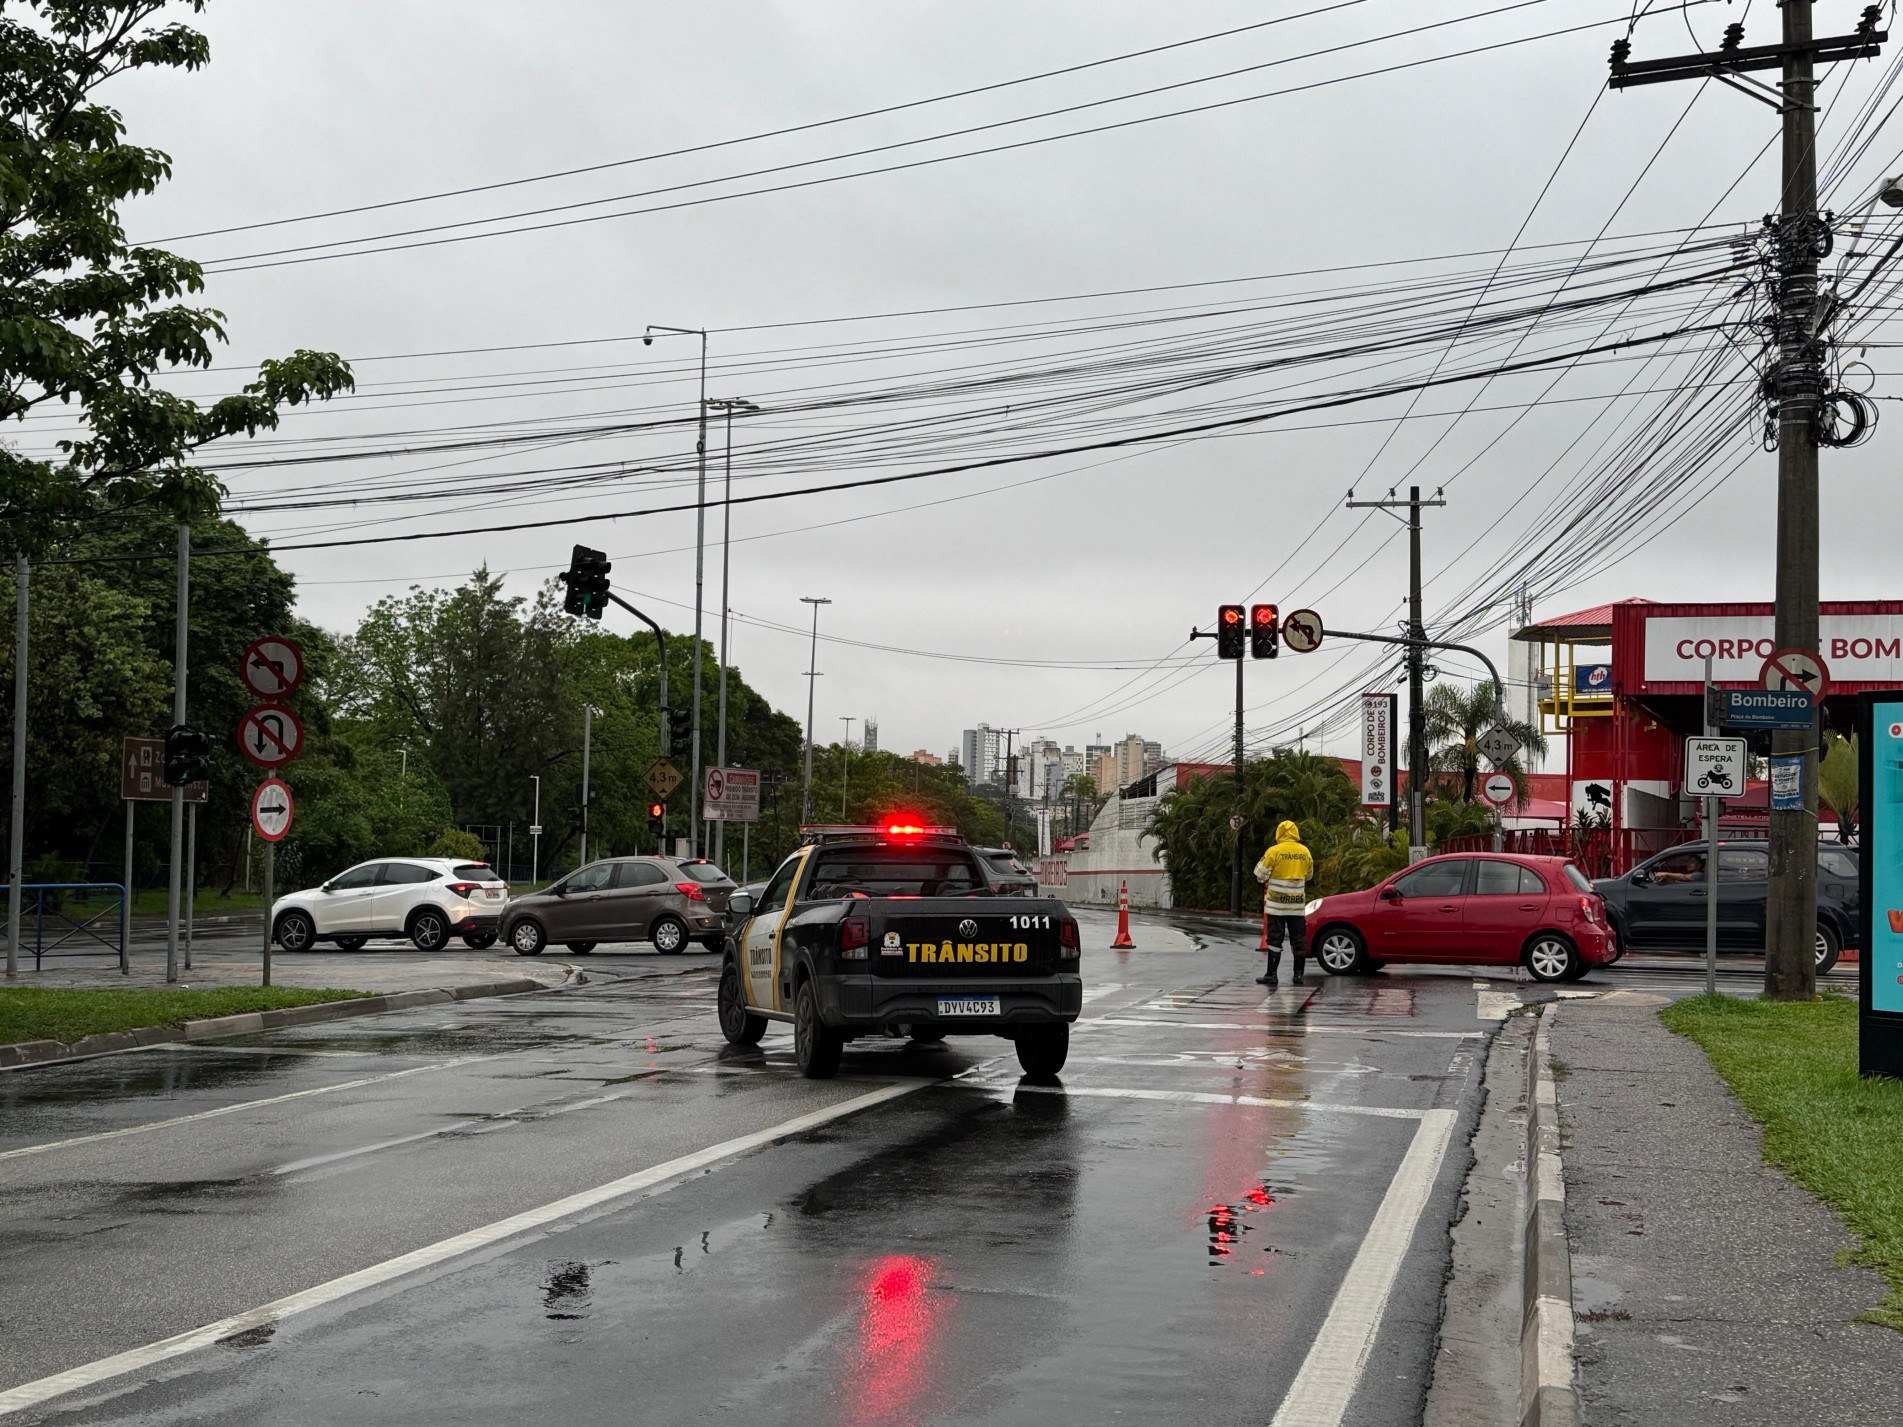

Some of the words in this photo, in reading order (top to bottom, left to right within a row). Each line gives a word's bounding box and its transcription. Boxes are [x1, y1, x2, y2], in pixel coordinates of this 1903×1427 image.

[1676, 638, 1775, 660] CORPO
[1831, 638, 1900, 659] BOM
[1730, 693, 1808, 708] Bombeiro
[1367, 709, 1375, 722] DE
[1367, 724, 1375, 756] CORPO
[1378, 710, 1386, 764] BOMBEIROS
[1484, 740, 1501, 752] 4,3
[1696, 742, 1720, 751] ÁREA
[1698, 755, 1733, 763] ESPERA
[650, 772, 667, 784] 4,3
[1280, 852, 1307, 860] TRÂNSITO
[1009, 916, 1050, 929] 1011
[906, 940, 1028, 962] TRÂNSITO
[944, 1001, 995, 1013] DYV4C93
